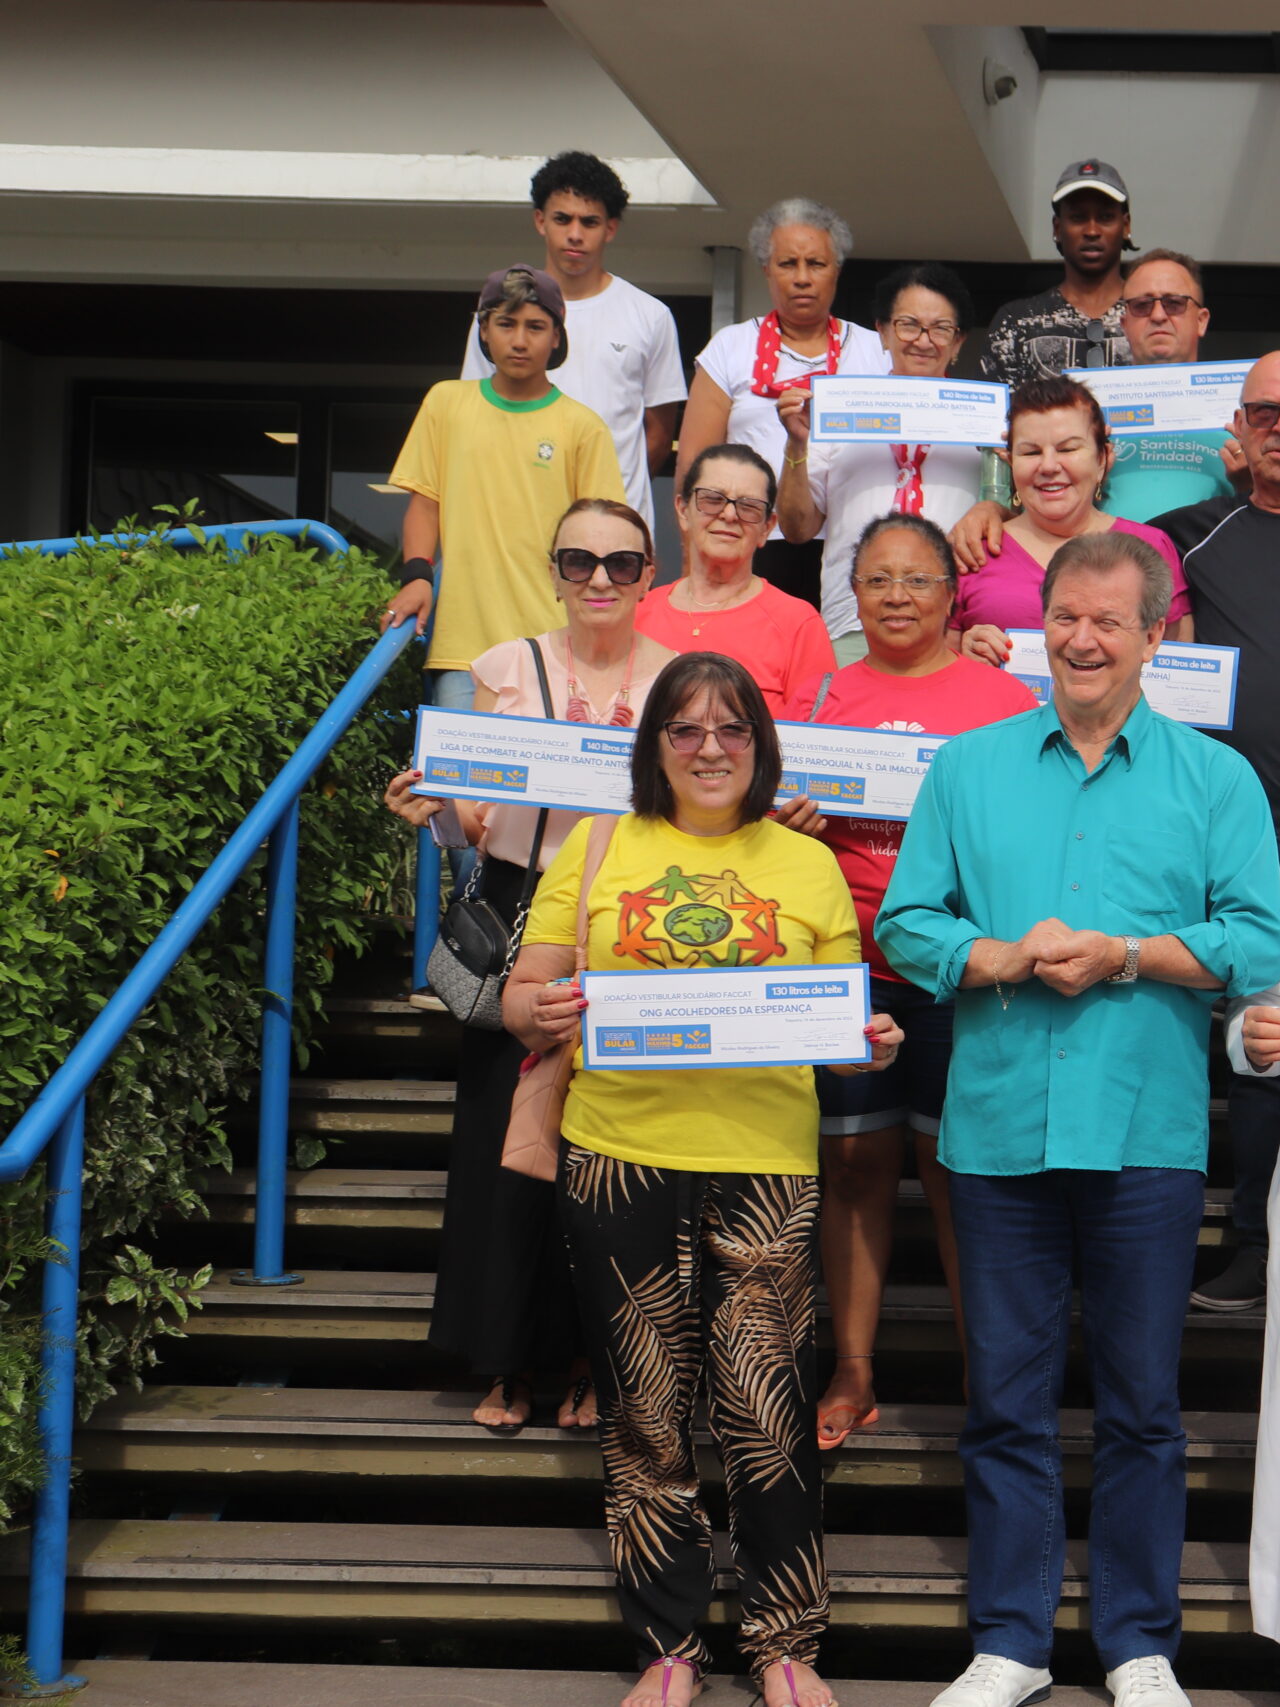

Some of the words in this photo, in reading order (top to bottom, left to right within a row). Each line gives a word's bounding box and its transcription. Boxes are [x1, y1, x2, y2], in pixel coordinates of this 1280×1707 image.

[1108, 392, 1142, 400] INSTITUTO
[1186, 388, 1218, 396] TRINDADE
[1140, 451, 1204, 464] Trindade
[468, 732, 506, 741] VESTIBULAR
[544, 739, 569, 748] FACCAT
[440, 742, 460, 751] LIGA
[462, 744, 474, 753] DE
[476, 746, 517, 758] COMBATE
[519, 750, 532, 759] AO
[534, 751, 569, 763] CÂNCER
[586, 742, 601, 750] 140
[602, 742, 620, 752] litros
[806, 758, 854, 769] PAROQUIAL
[492, 770, 504, 784] 5
[830, 782, 841, 796] 5
[867, 840, 898, 857] Vida
[604, 993, 637, 1002] DOAÇÃO
[639, 992, 680, 1000] VESTIBULAR
[723, 990, 752, 998] FACCAT
[772, 986, 788, 996] 130
[788, 986, 810, 996] litros
[811, 985, 824, 994] de
[824, 984, 843, 994] leite
[640, 1008, 662, 1018] ONG
[664, 1006, 737, 1017] ACOLHEDORES
[739, 1006, 753, 1014] DA
[755, 1004, 812, 1014] ESPERANÇA
[672, 1034, 683, 1047] 5
